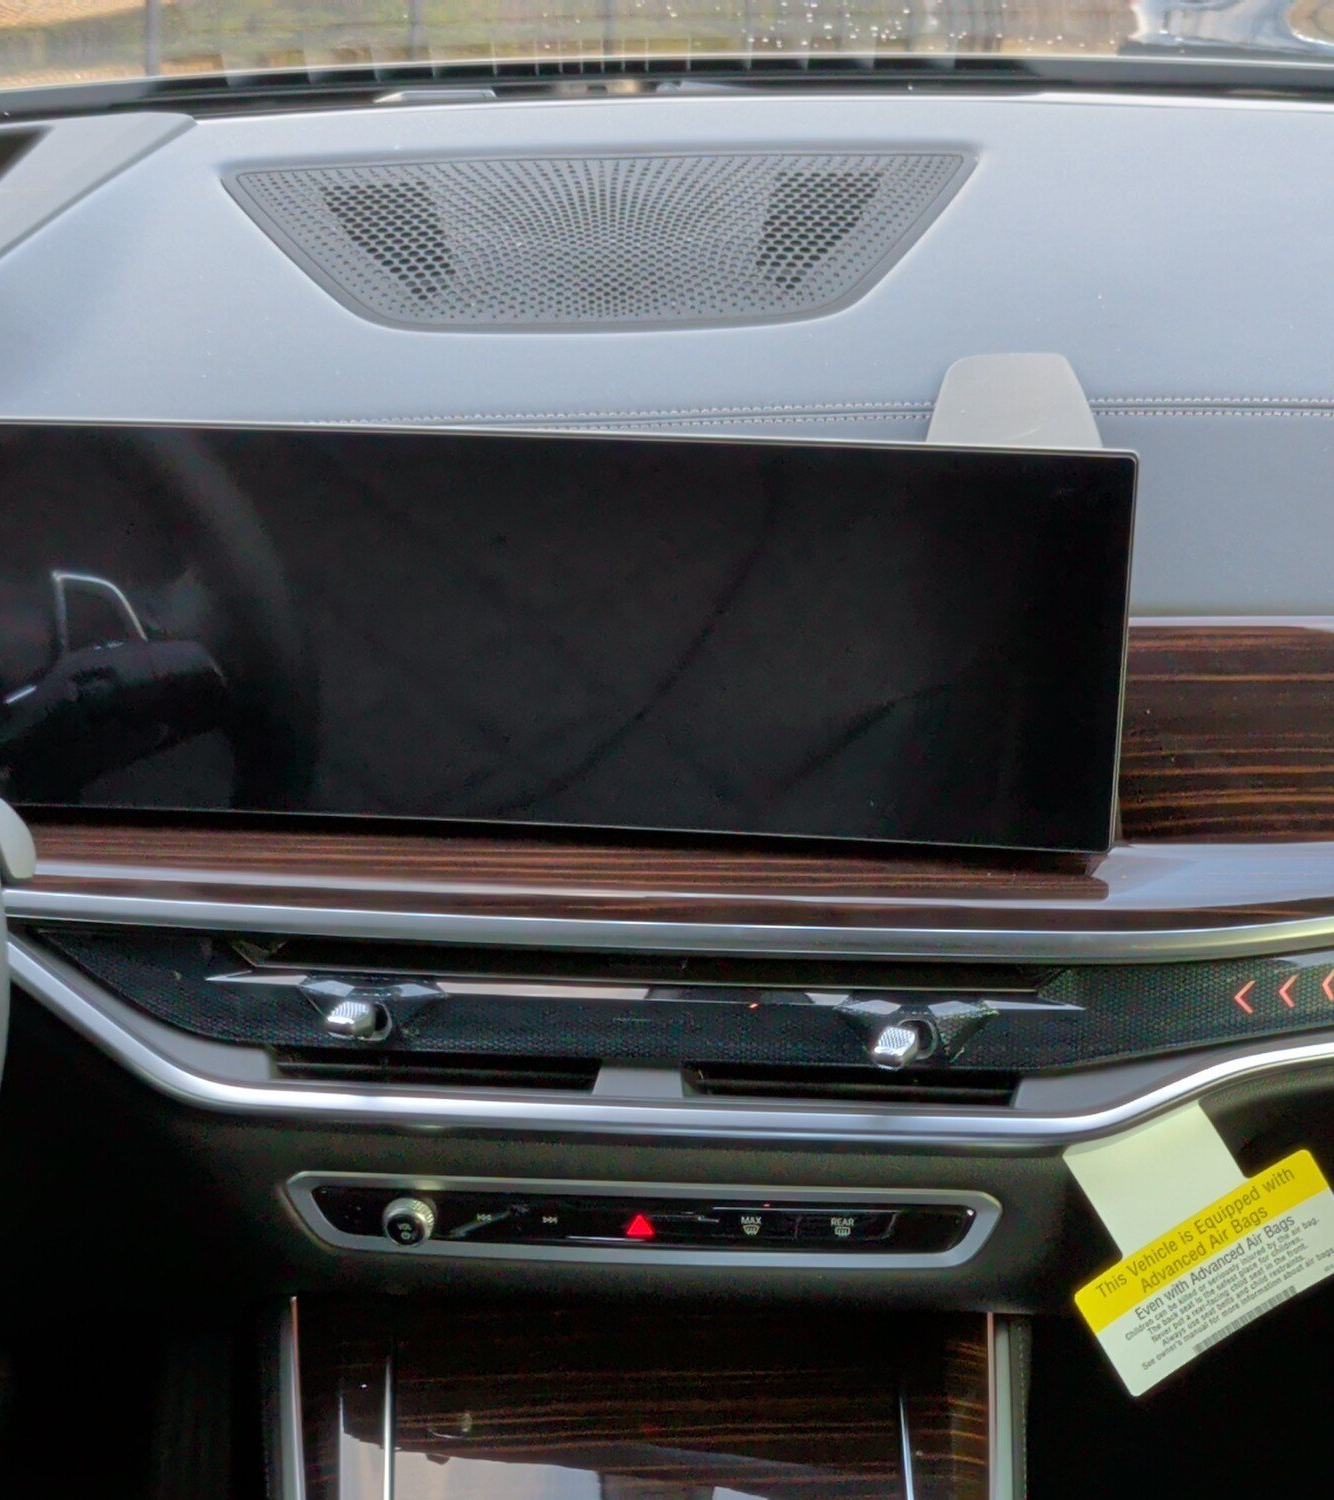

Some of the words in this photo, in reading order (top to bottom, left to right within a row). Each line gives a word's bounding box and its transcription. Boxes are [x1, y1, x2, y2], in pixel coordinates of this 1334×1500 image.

[741, 1216, 762, 1225] MAX
[830, 1217, 854, 1226] REAR
[1096, 1274, 1128, 1298] This
[1127, 1241, 1179, 1278] Vehicle
[1178, 1230, 1194, 1245] is
[1194, 1186, 1261, 1234] Equipped
[1262, 1167, 1295, 1193] with
[1138, 1241, 1207, 1293] Advanced
[1206, 1230, 1230, 1249] Air
[1230, 1207, 1268, 1234] Bags
[1134, 1296, 1164, 1320] Even
[1163, 1277, 1190, 1301] with
[1188, 1242, 1245, 1285] Advanced
[1243, 1233, 1265, 1250] Air
[1262, 1215, 1295, 1239] Bags
